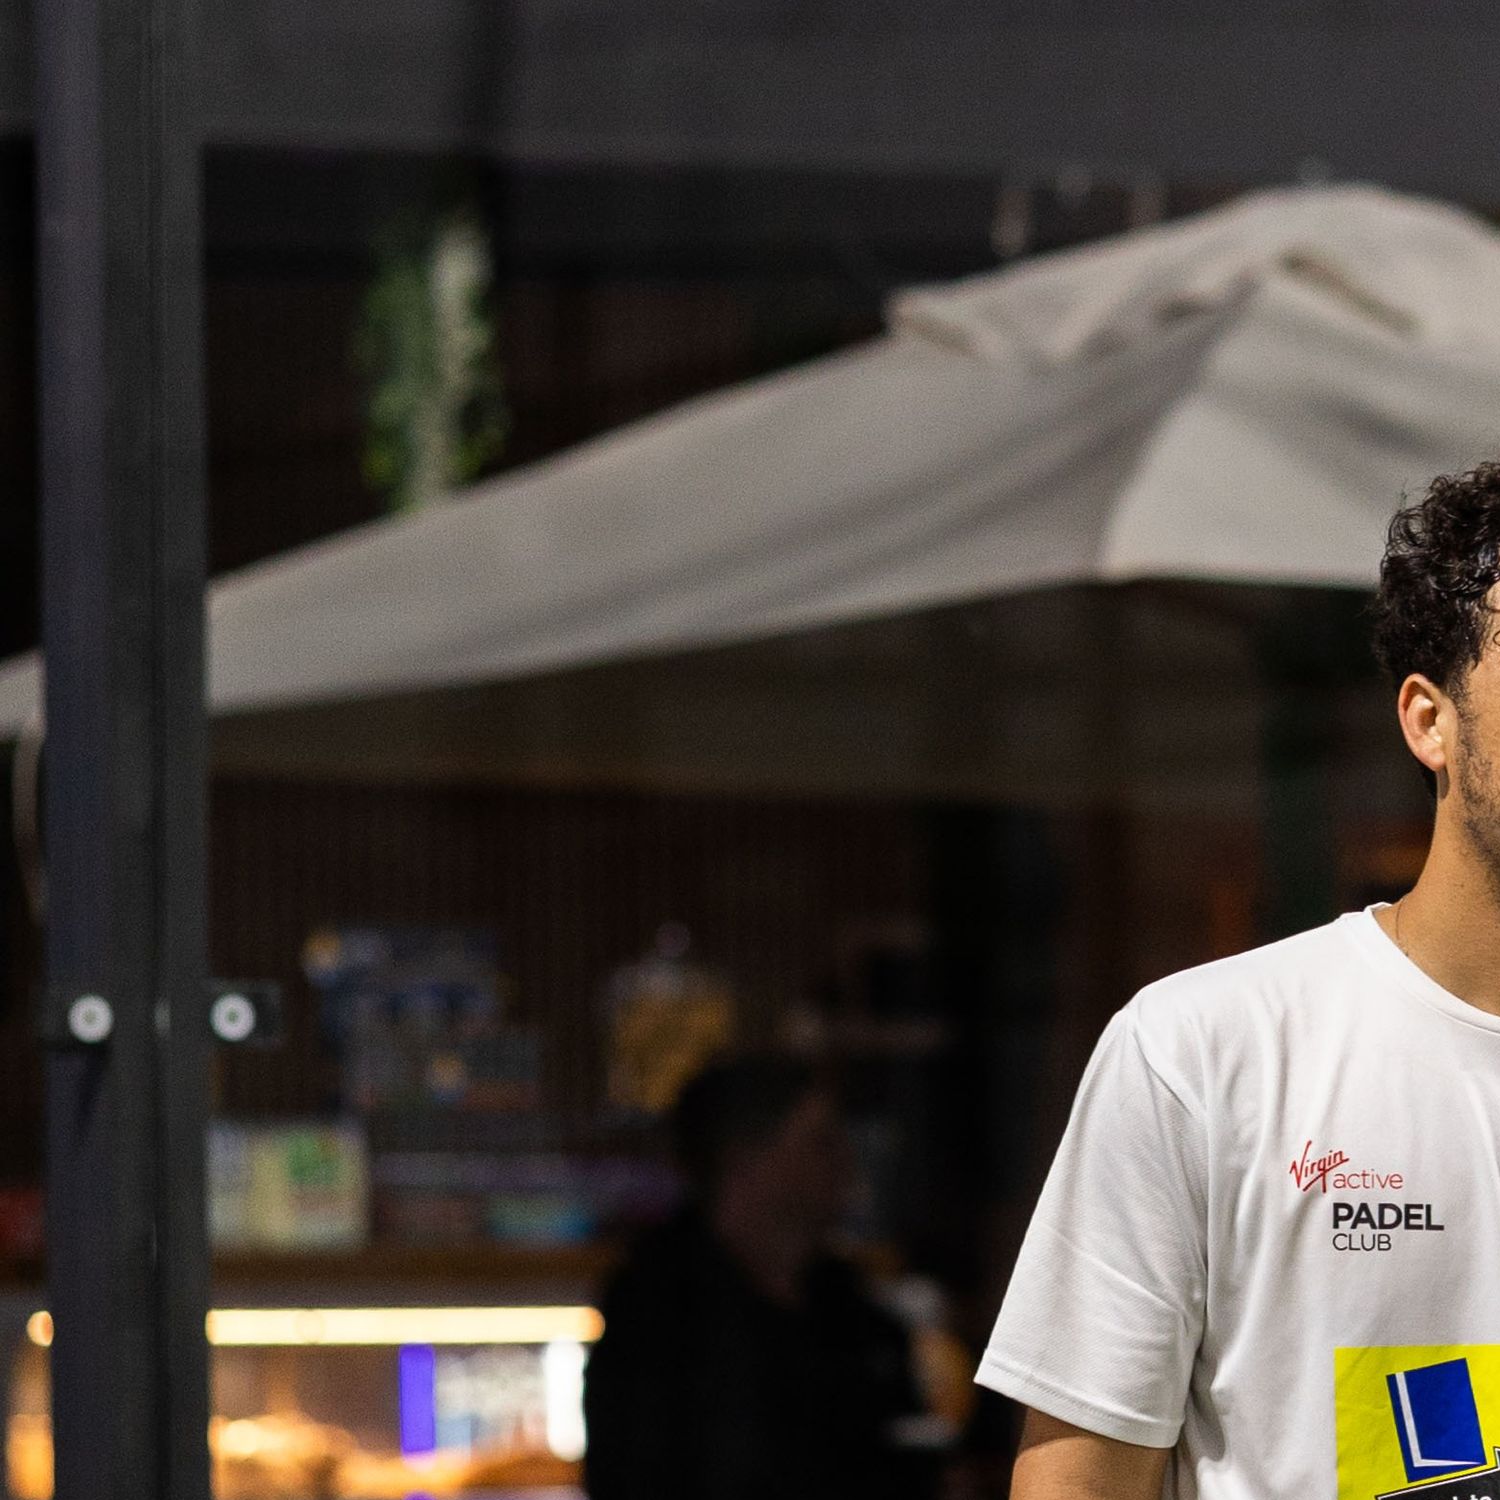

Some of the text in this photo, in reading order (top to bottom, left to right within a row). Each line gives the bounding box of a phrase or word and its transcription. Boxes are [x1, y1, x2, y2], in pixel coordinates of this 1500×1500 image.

[1289, 1140, 1403, 1193] Virgin active
[1332, 1202, 1445, 1231] PADEL
[1332, 1233, 1392, 1251] CLUB
